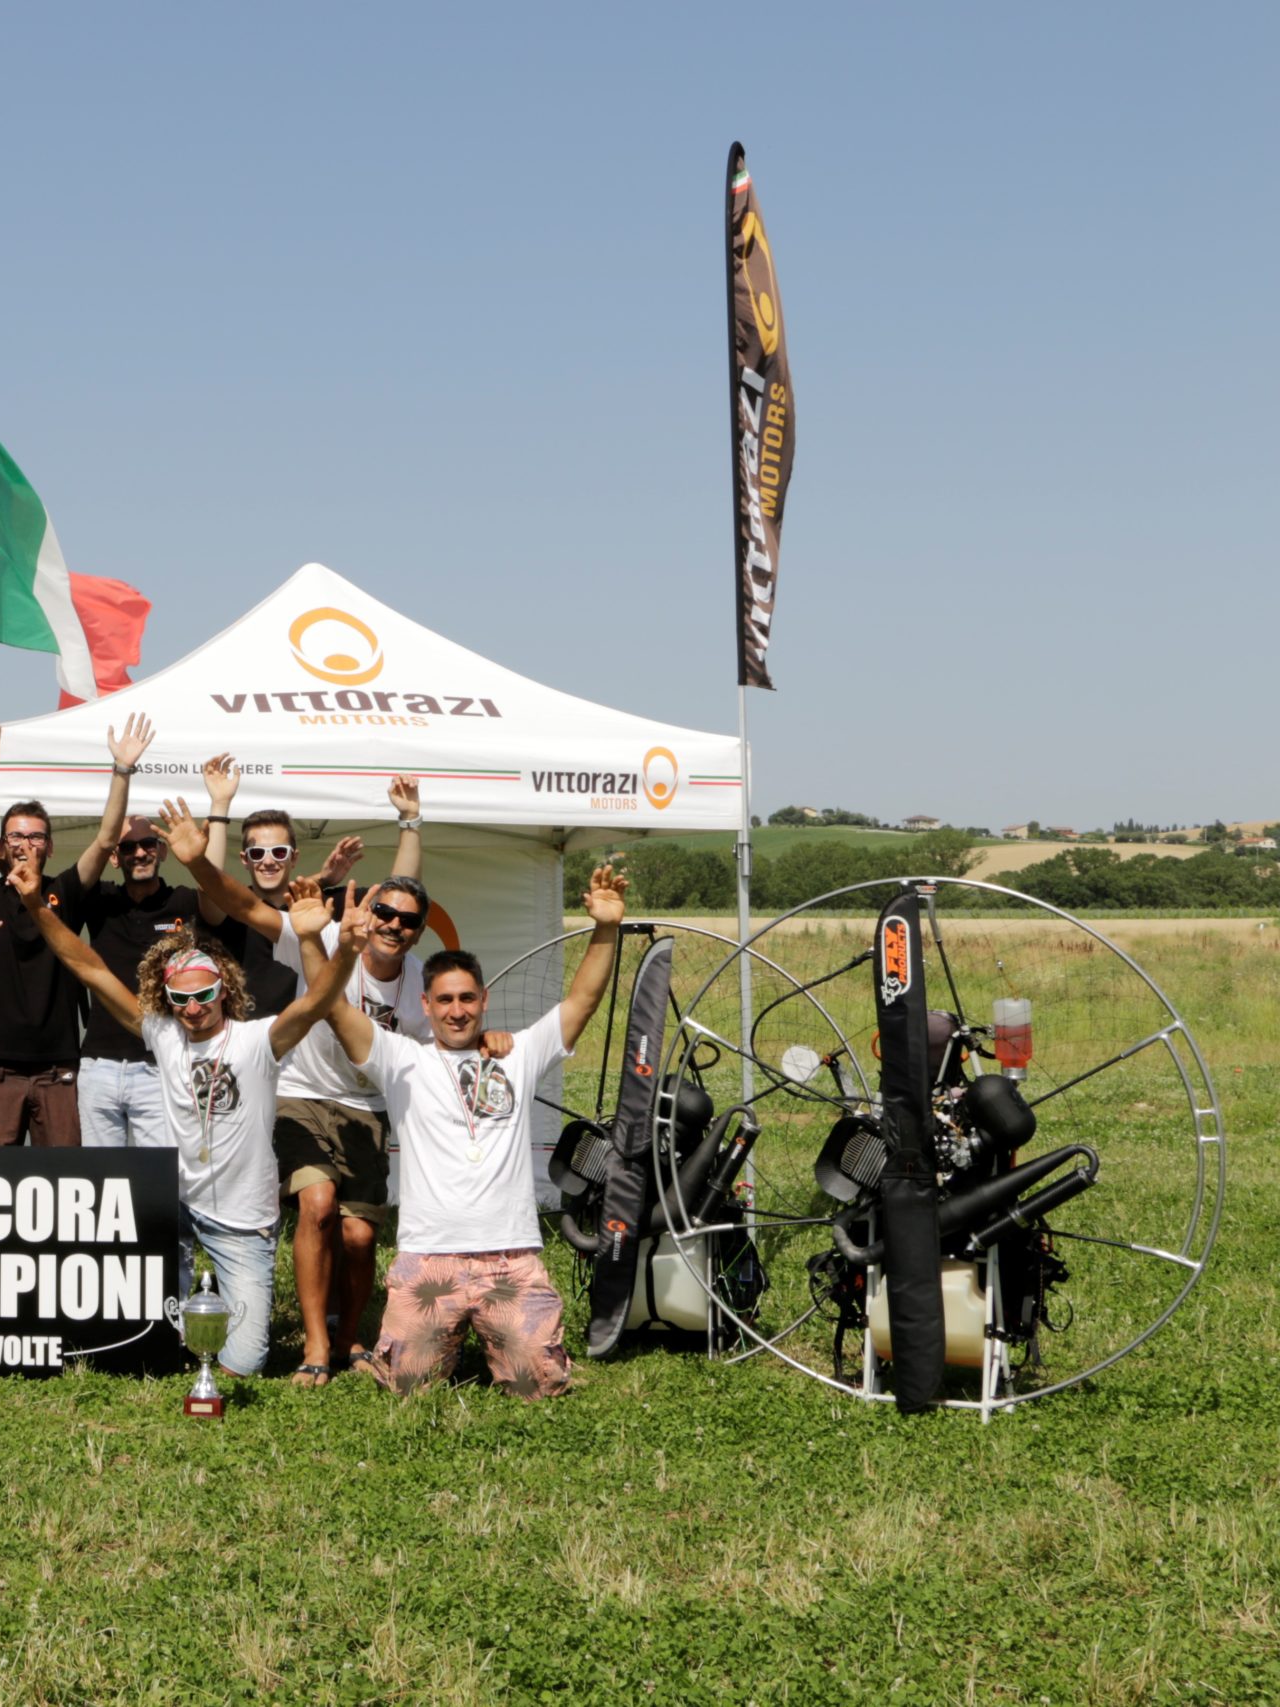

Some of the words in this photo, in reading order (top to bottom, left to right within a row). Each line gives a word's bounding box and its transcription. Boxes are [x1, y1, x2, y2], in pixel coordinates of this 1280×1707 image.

[759, 382, 786, 518] MOTORS
[299, 714, 430, 727] MOTORS
[136, 763, 188, 775] ASSION
[590, 797, 638, 811] MOTORS
[884, 925, 899, 976] FLY
[896, 922, 908, 985] PRODUCTS
